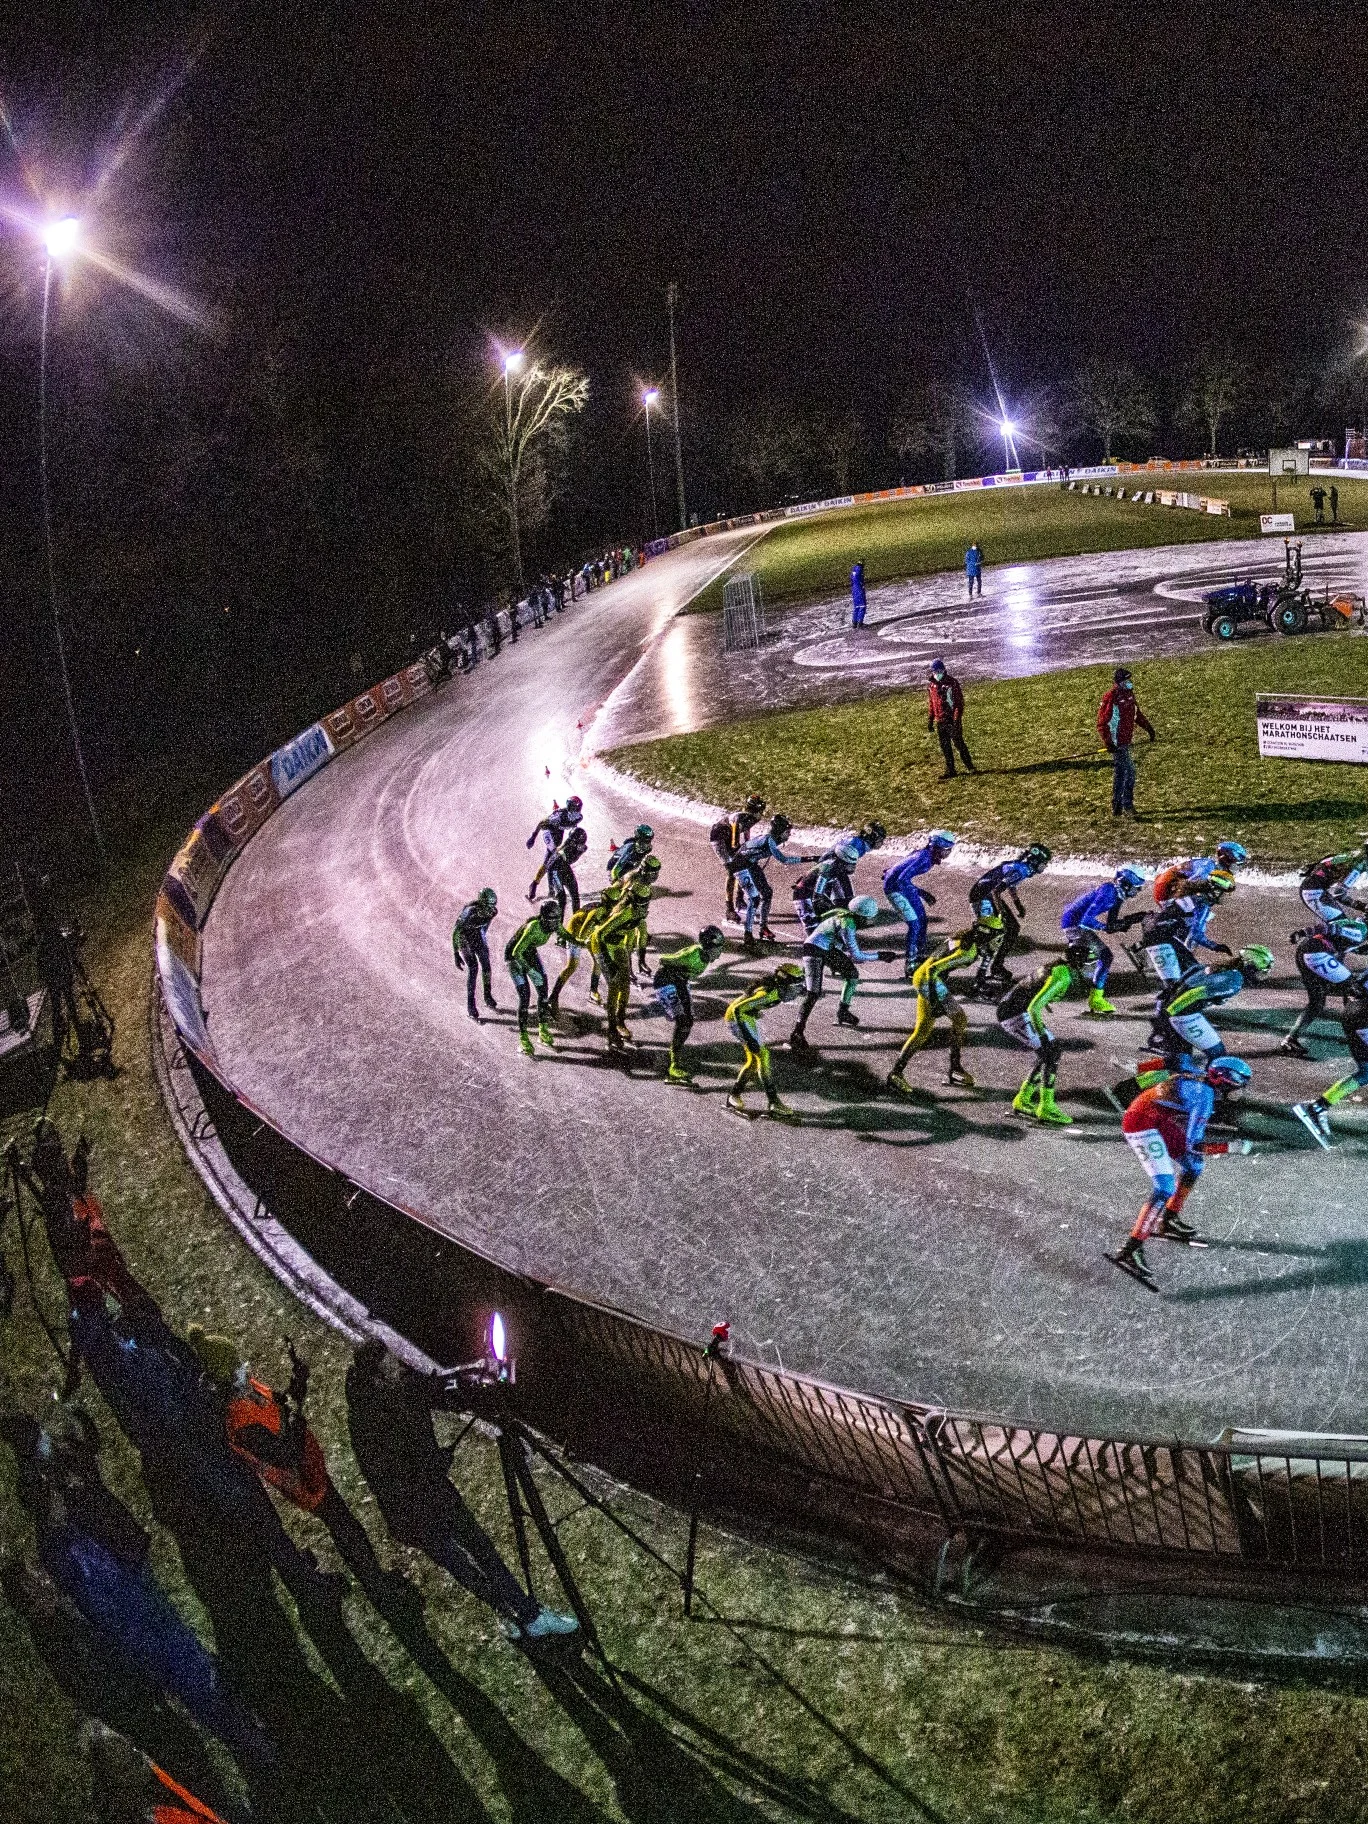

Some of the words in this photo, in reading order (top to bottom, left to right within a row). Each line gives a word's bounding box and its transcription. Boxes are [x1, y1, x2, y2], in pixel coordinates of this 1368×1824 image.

[1262, 722, 1298, 732] WELKOM
[1300, 724, 1313, 732] BIJ
[1314, 725, 1331, 734] HET
[1262, 729, 1357, 743] MARATHONSCHAATSEN
[1315, 956, 1340, 976] 70
